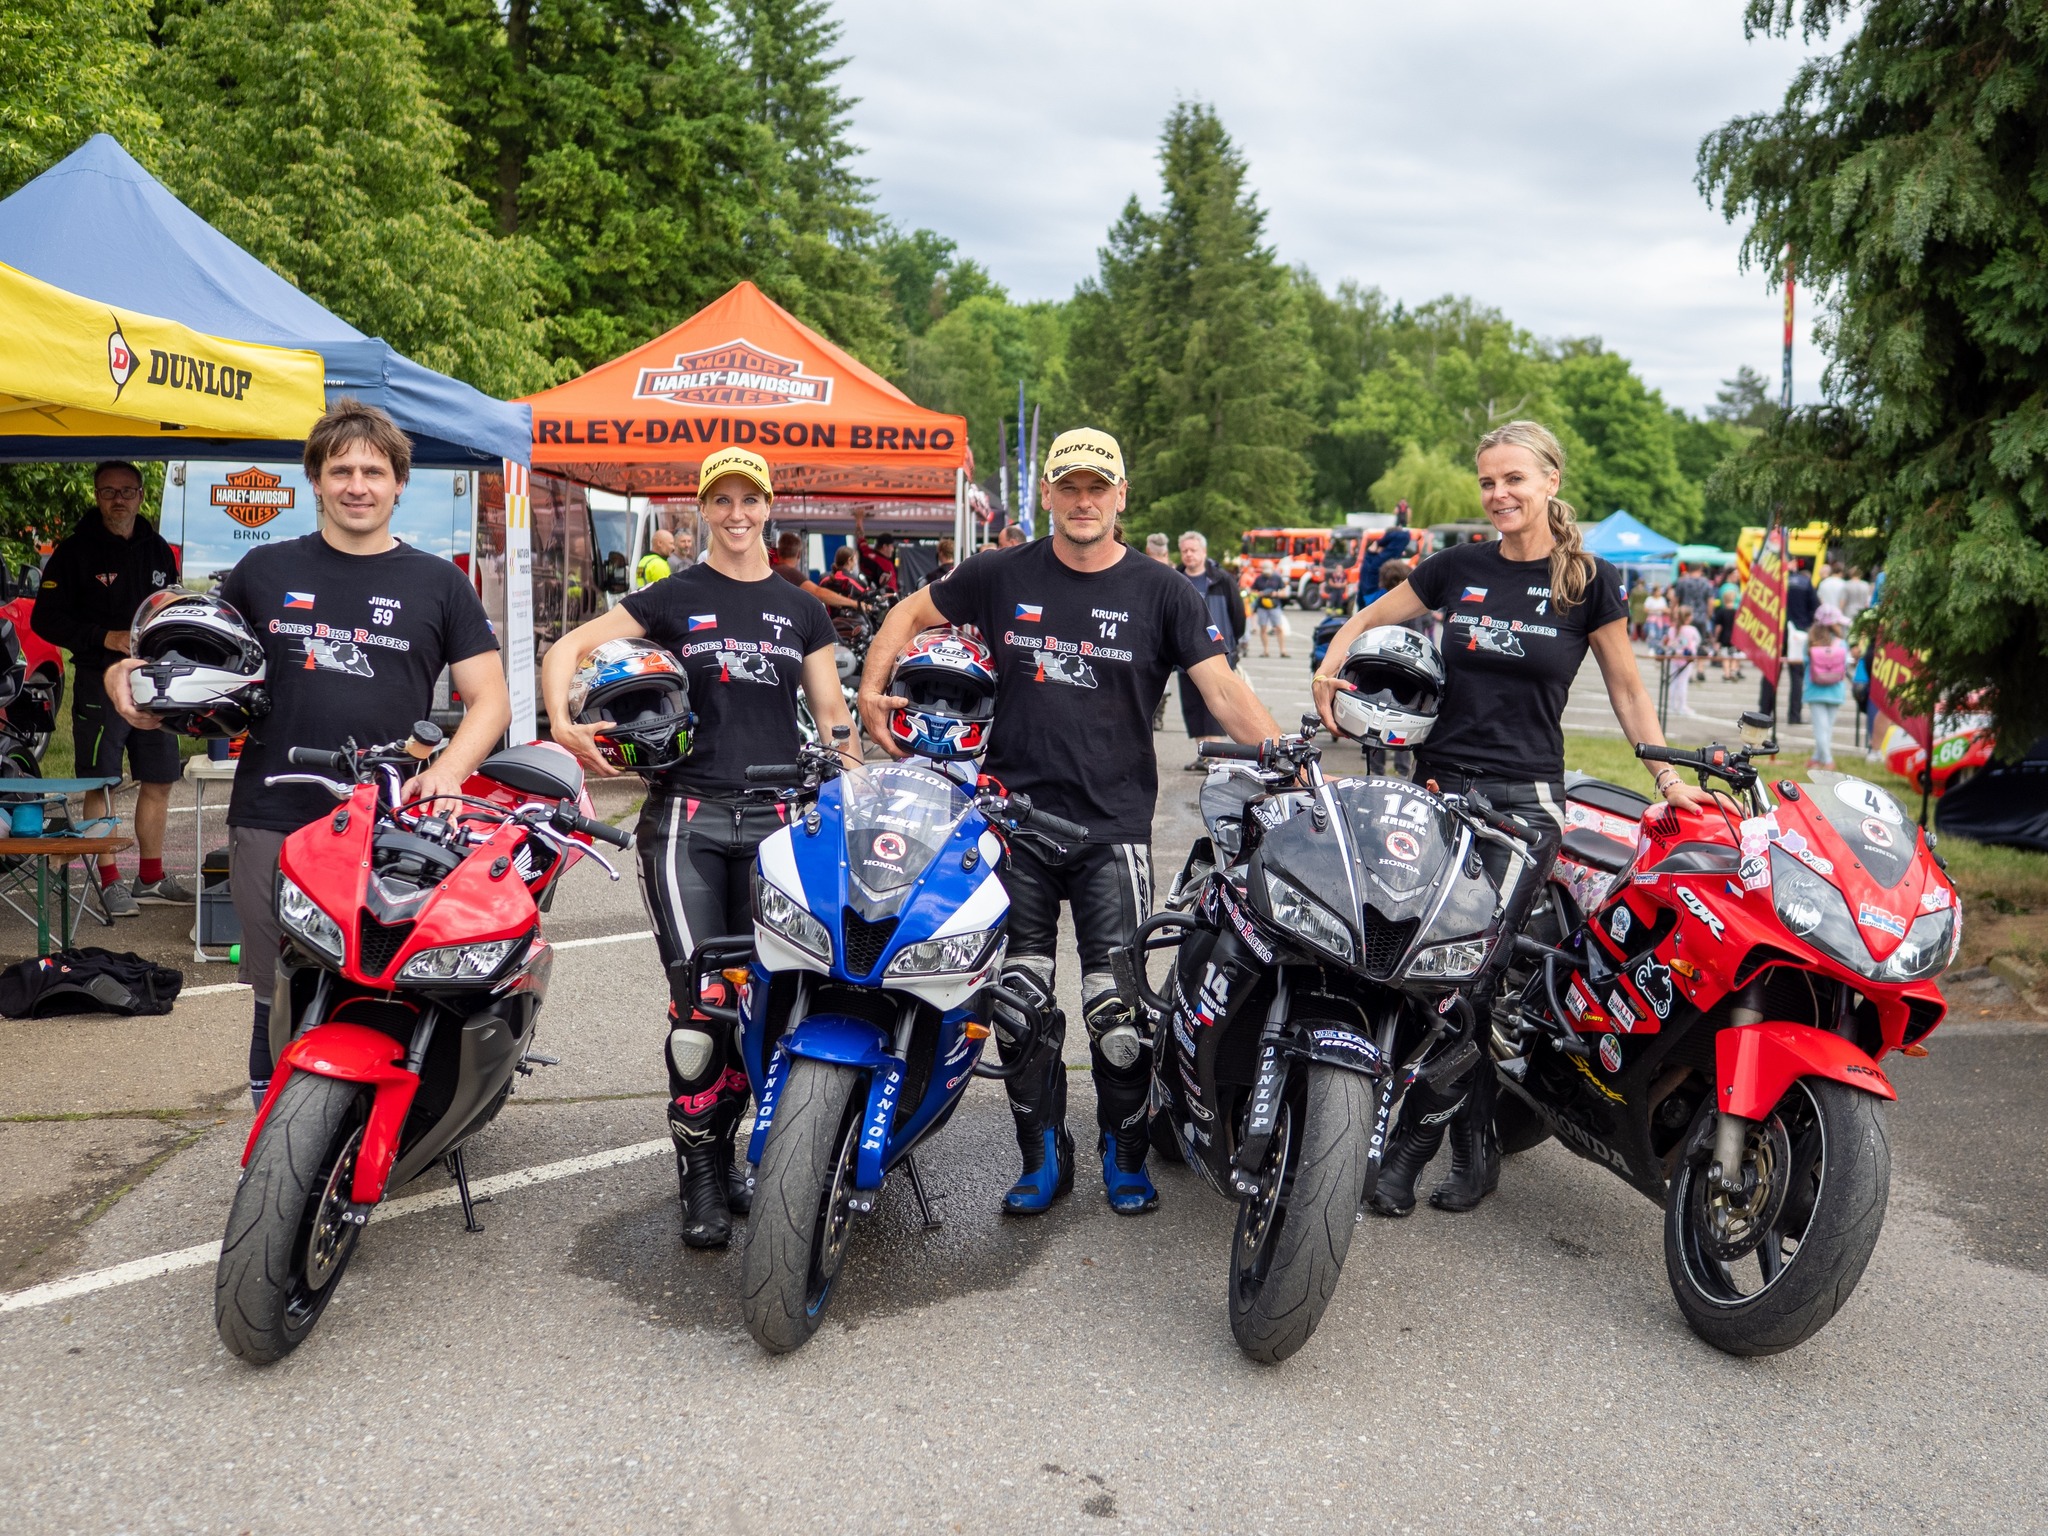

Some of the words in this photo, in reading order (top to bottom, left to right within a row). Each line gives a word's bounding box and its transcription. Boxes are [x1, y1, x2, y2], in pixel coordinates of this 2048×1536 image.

[695, 353, 783, 373] MOTOR
[147, 348, 253, 401] DUNLOP
[652, 370, 815, 397] HARLEY-DAVIDSON
[690, 388, 783, 404] CYCLES
[531, 418, 836, 448] RLEY-DAVIDSON
[850, 425, 955, 451] BRNO
[1053, 443, 1115, 461] DUNLOP
[704, 457, 763, 478] DUNLOP
[233, 470, 273, 487] MOTOR
[216, 488, 290, 505] HARLEY-DAVIDSON
[232, 506, 272, 524] CYCLES
[233, 529, 271, 540] BRNO
[368, 596, 402, 610] JIRKA
[1535, 599, 1548, 616] 4
[371, 608, 394, 626] 59
[762, 612, 793, 627] KEJKA
[1091, 608, 1130, 623] KRUPIČ
[773, 625, 783, 640] 7
[1098, 621, 1118, 640] 14
[936, 647, 968, 659] HJC
[1940, 738, 1965, 763] 66
[869, 767, 952, 792] DUNLOP
[887, 789, 919, 812] 7
[1368, 779, 1448, 813] DUNLOP
[1864, 789, 1881, 814] 4
[1383, 793, 1430, 827] 14
[1863, 844, 1899, 861] HONDA
[521, 869, 543, 882] ONDA
[862, 859, 905, 874] HONDA
[1379, 858, 1421, 876] HONDA
[1677, 886, 1725, 945] CBR
[1860, 903, 1907, 934] HRC
[1203, 961, 1230, 1005] 14
[1174, 980, 1202, 1027] DUNLOP
[1320, 1039, 1376, 1062] REPSOL
[1251, 1045, 1275, 1128] DUNLOP
[1565, 1051, 1628, 1105] Sport
[756, 1050, 780, 1131] DUNLOP
[862, 1071, 900, 1151] DUNLOP
[1368, 1079, 1394, 1160] DUNLOP
